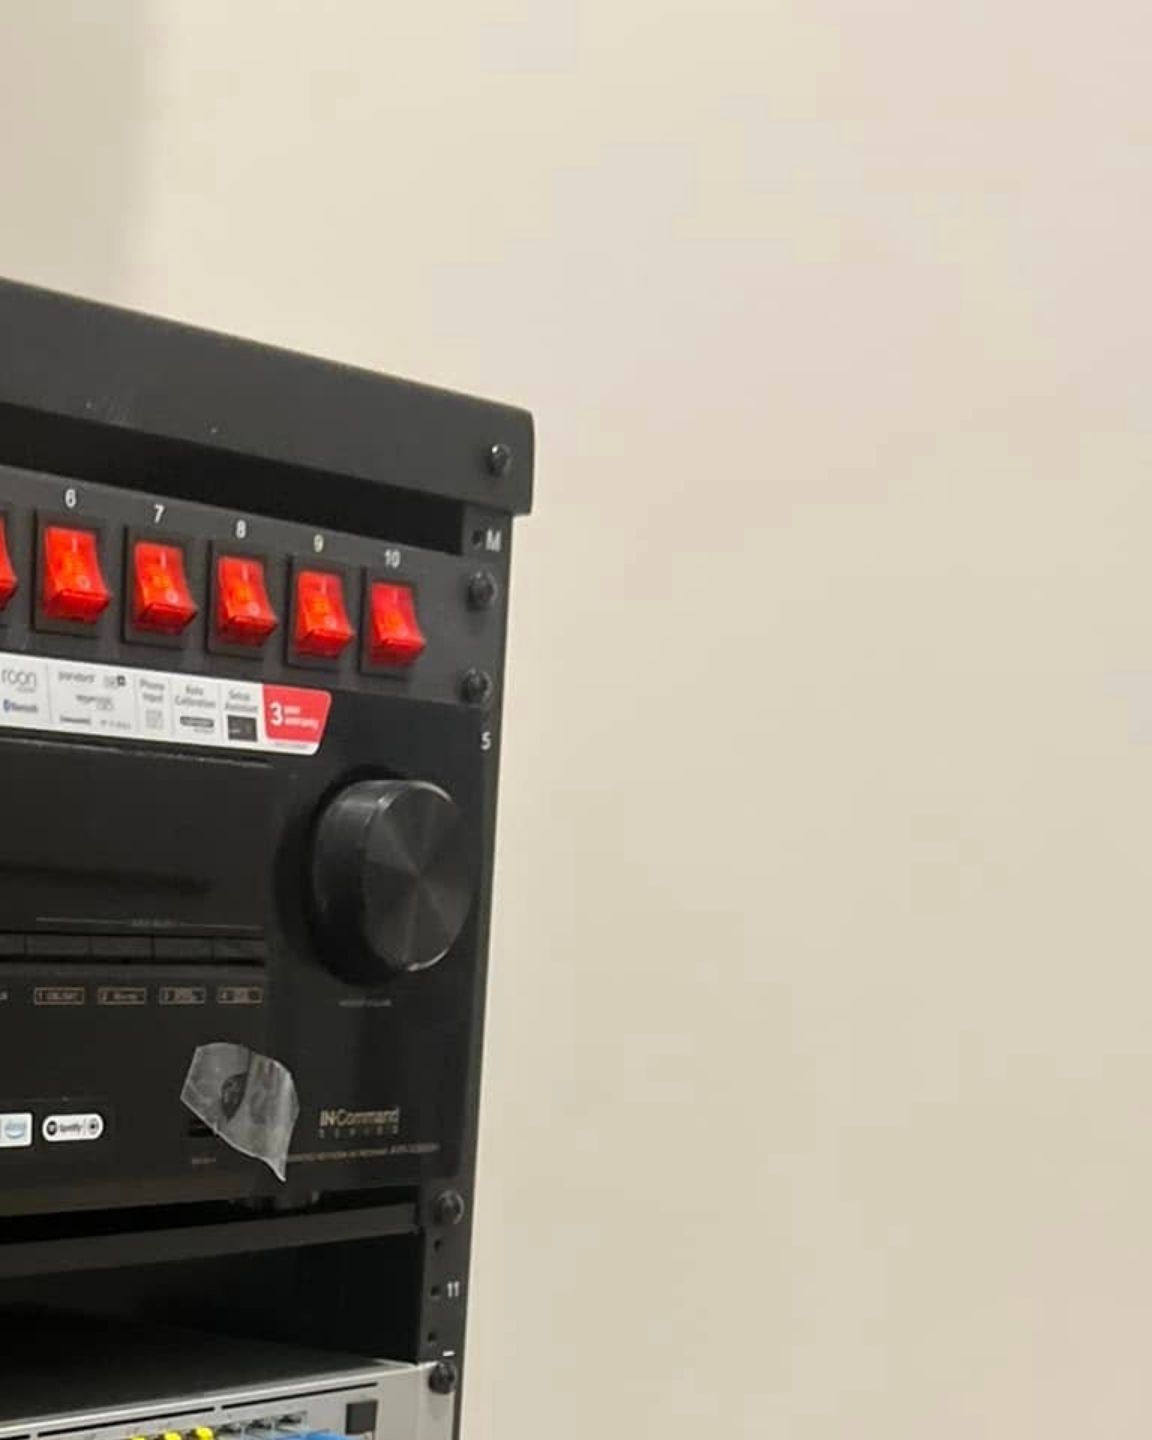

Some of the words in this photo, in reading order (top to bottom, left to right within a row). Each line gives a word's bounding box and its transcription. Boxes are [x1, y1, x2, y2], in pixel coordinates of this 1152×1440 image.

[65, 489, 76, 508] 6
[154, 505, 164, 523] 7
[236, 520, 246, 539] 8
[314, 534, 324, 552] 9
[486, 530, 501, 551] M
[384, 550, 400, 568] 10
[270, 702, 283, 726] 3
[447, 1281, 460, 1297] 11
